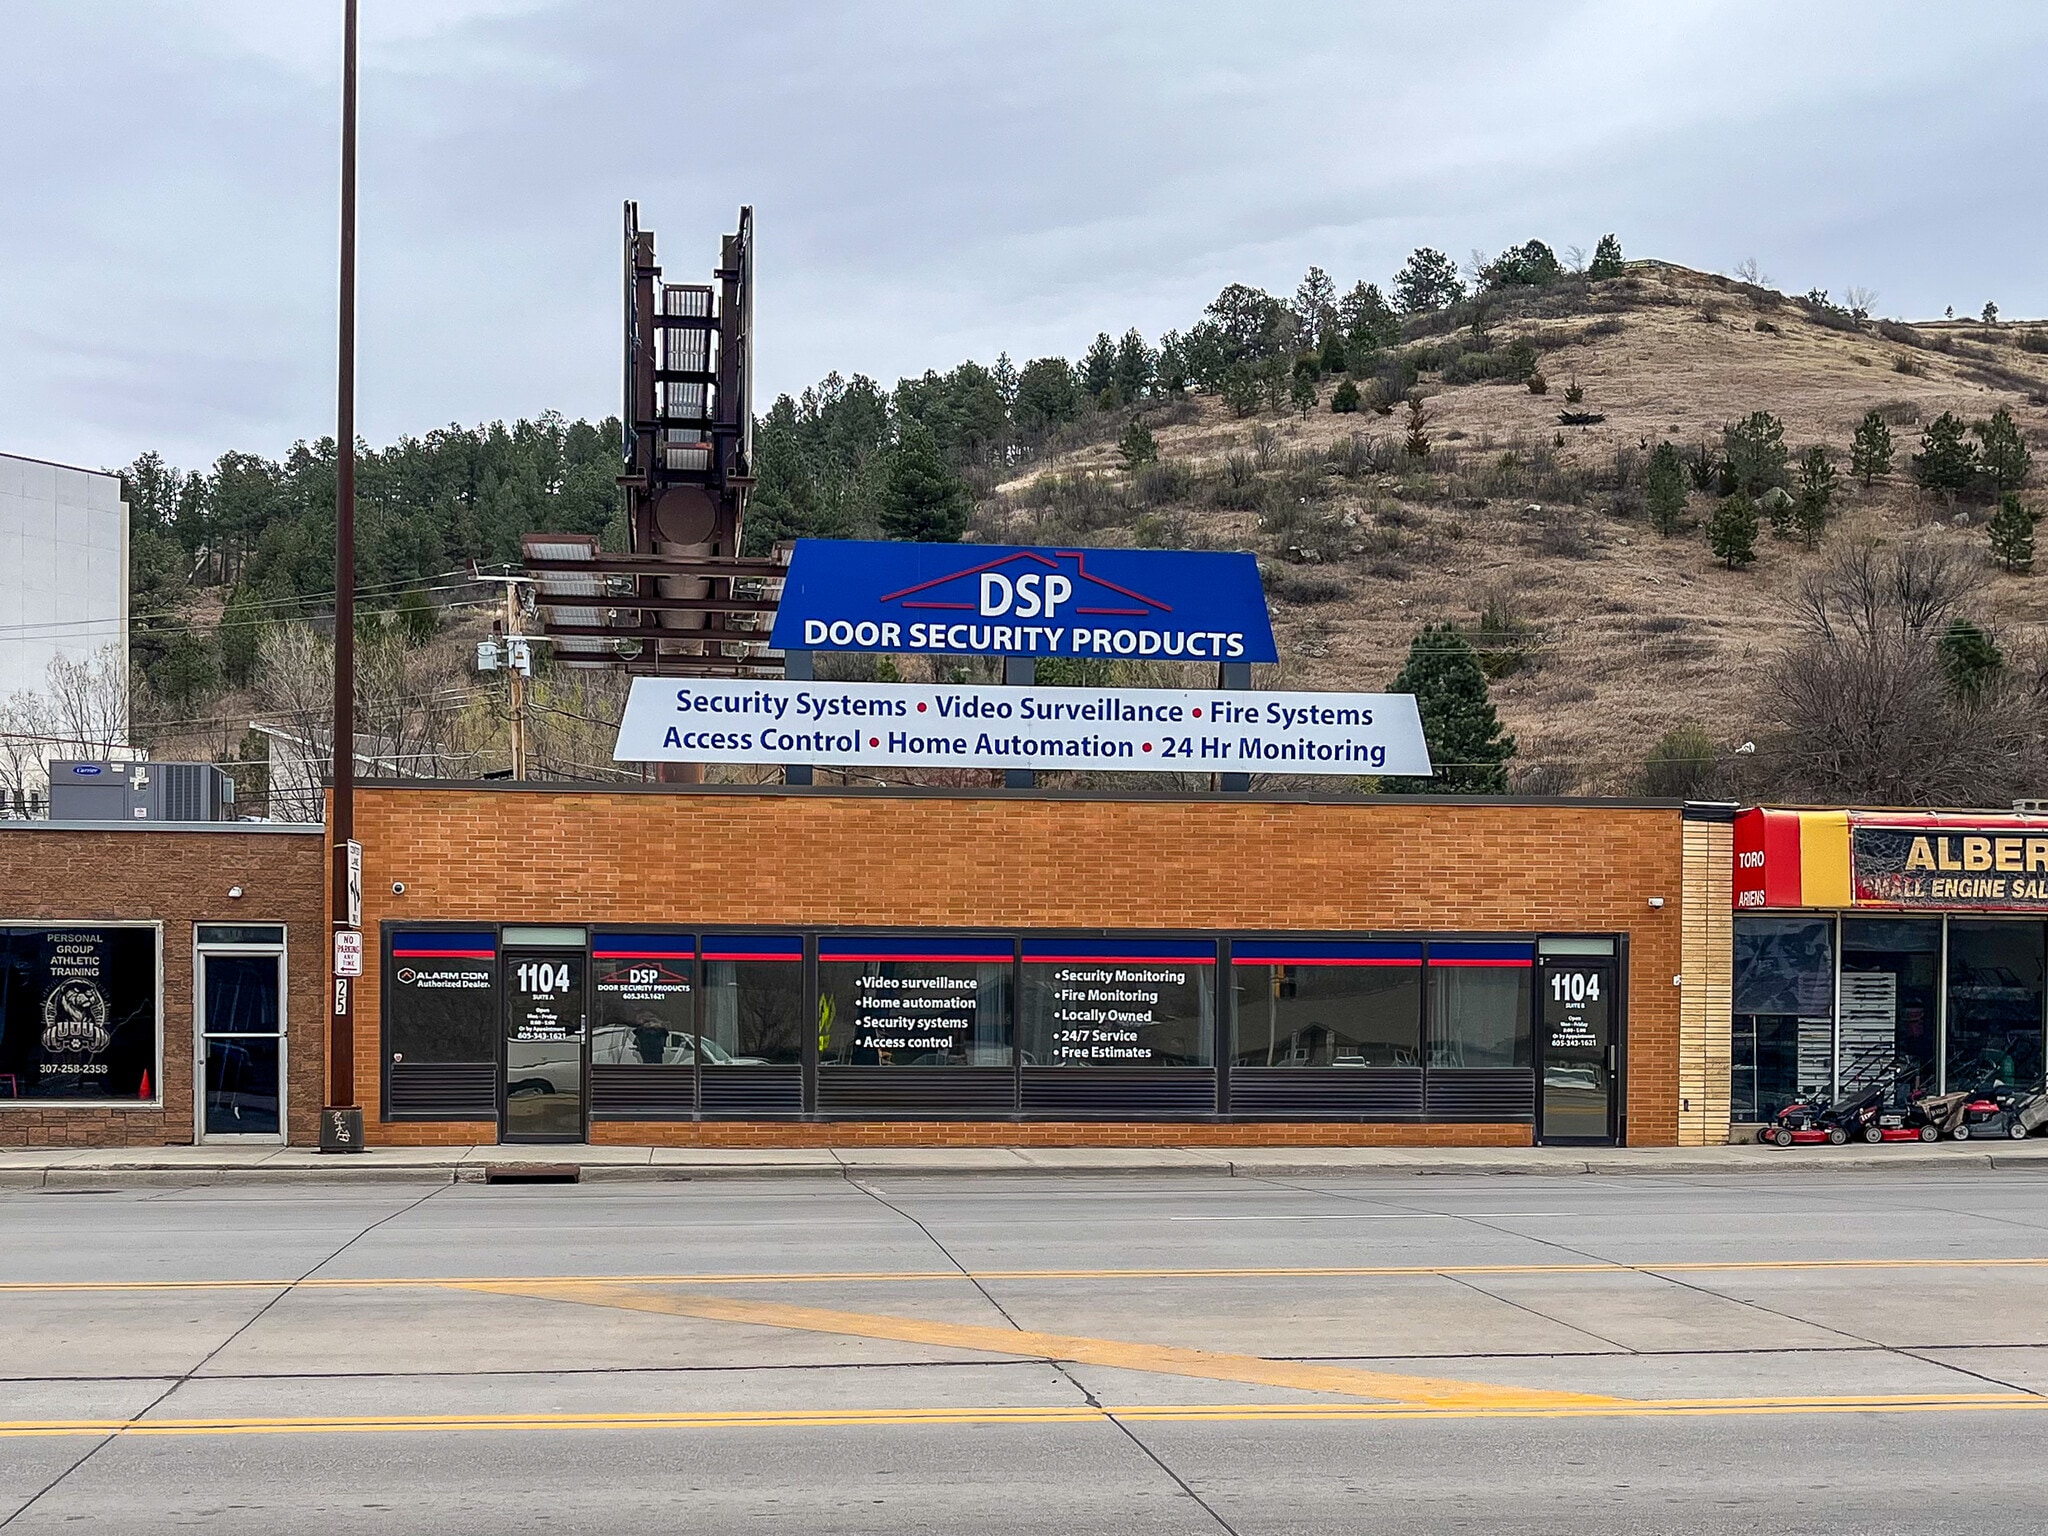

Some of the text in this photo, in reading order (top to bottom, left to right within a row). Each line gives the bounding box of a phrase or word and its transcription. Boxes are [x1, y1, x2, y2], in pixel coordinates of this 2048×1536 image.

[979, 572, 1072, 618] DSP
[804, 619, 1244, 657] DOOR SECURITY PRODUCTS
[676, 690, 1373, 730] Security Systems Video Surveillance Fire Systems
[662, 726, 1386, 767] Access Control Home Automation 24 Hr Monitoring
[1739, 851, 1765, 869] TORO
[1905, 836, 2048, 872] ALBER
[1931, 878, 2006, 898] ENGINE
[2011, 879, 2048, 899] SAL
[1738, 889, 1765, 907] ARIENS
[47, 934, 104, 942] PERSONAL
[343, 936, 354, 944] NO
[56, 945, 94, 954] GROUP
[337, 945, 360, 953] PARKING
[50, 956, 100, 965] ATHLETIC
[50, 967, 100, 976] TRAINING
[517, 963, 570, 993] 1104
[630, 969, 658, 983] DSP
[1061, 969, 1186, 985] Security Monitoring
[417, 979, 462, 988] Authorized
[862, 976, 978, 989] Video surveillance
[1551, 973, 1600, 1001] 1104
[862, 996, 977, 1009] Home automation
[1061, 989, 1159, 1004] Fire Monitoring
[1061, 1008, 1153, 1024] Locally Owned
[863, 1016, 969, 1031] Security systems
[863, 1036, 953, 1048] Access control
[1061, 1029, 1138, 1042] 24/7 Service
[1061, 1046, 1152, 1058] Free Estimates
[39, 1064, 109, 1074] 307-258-2358
